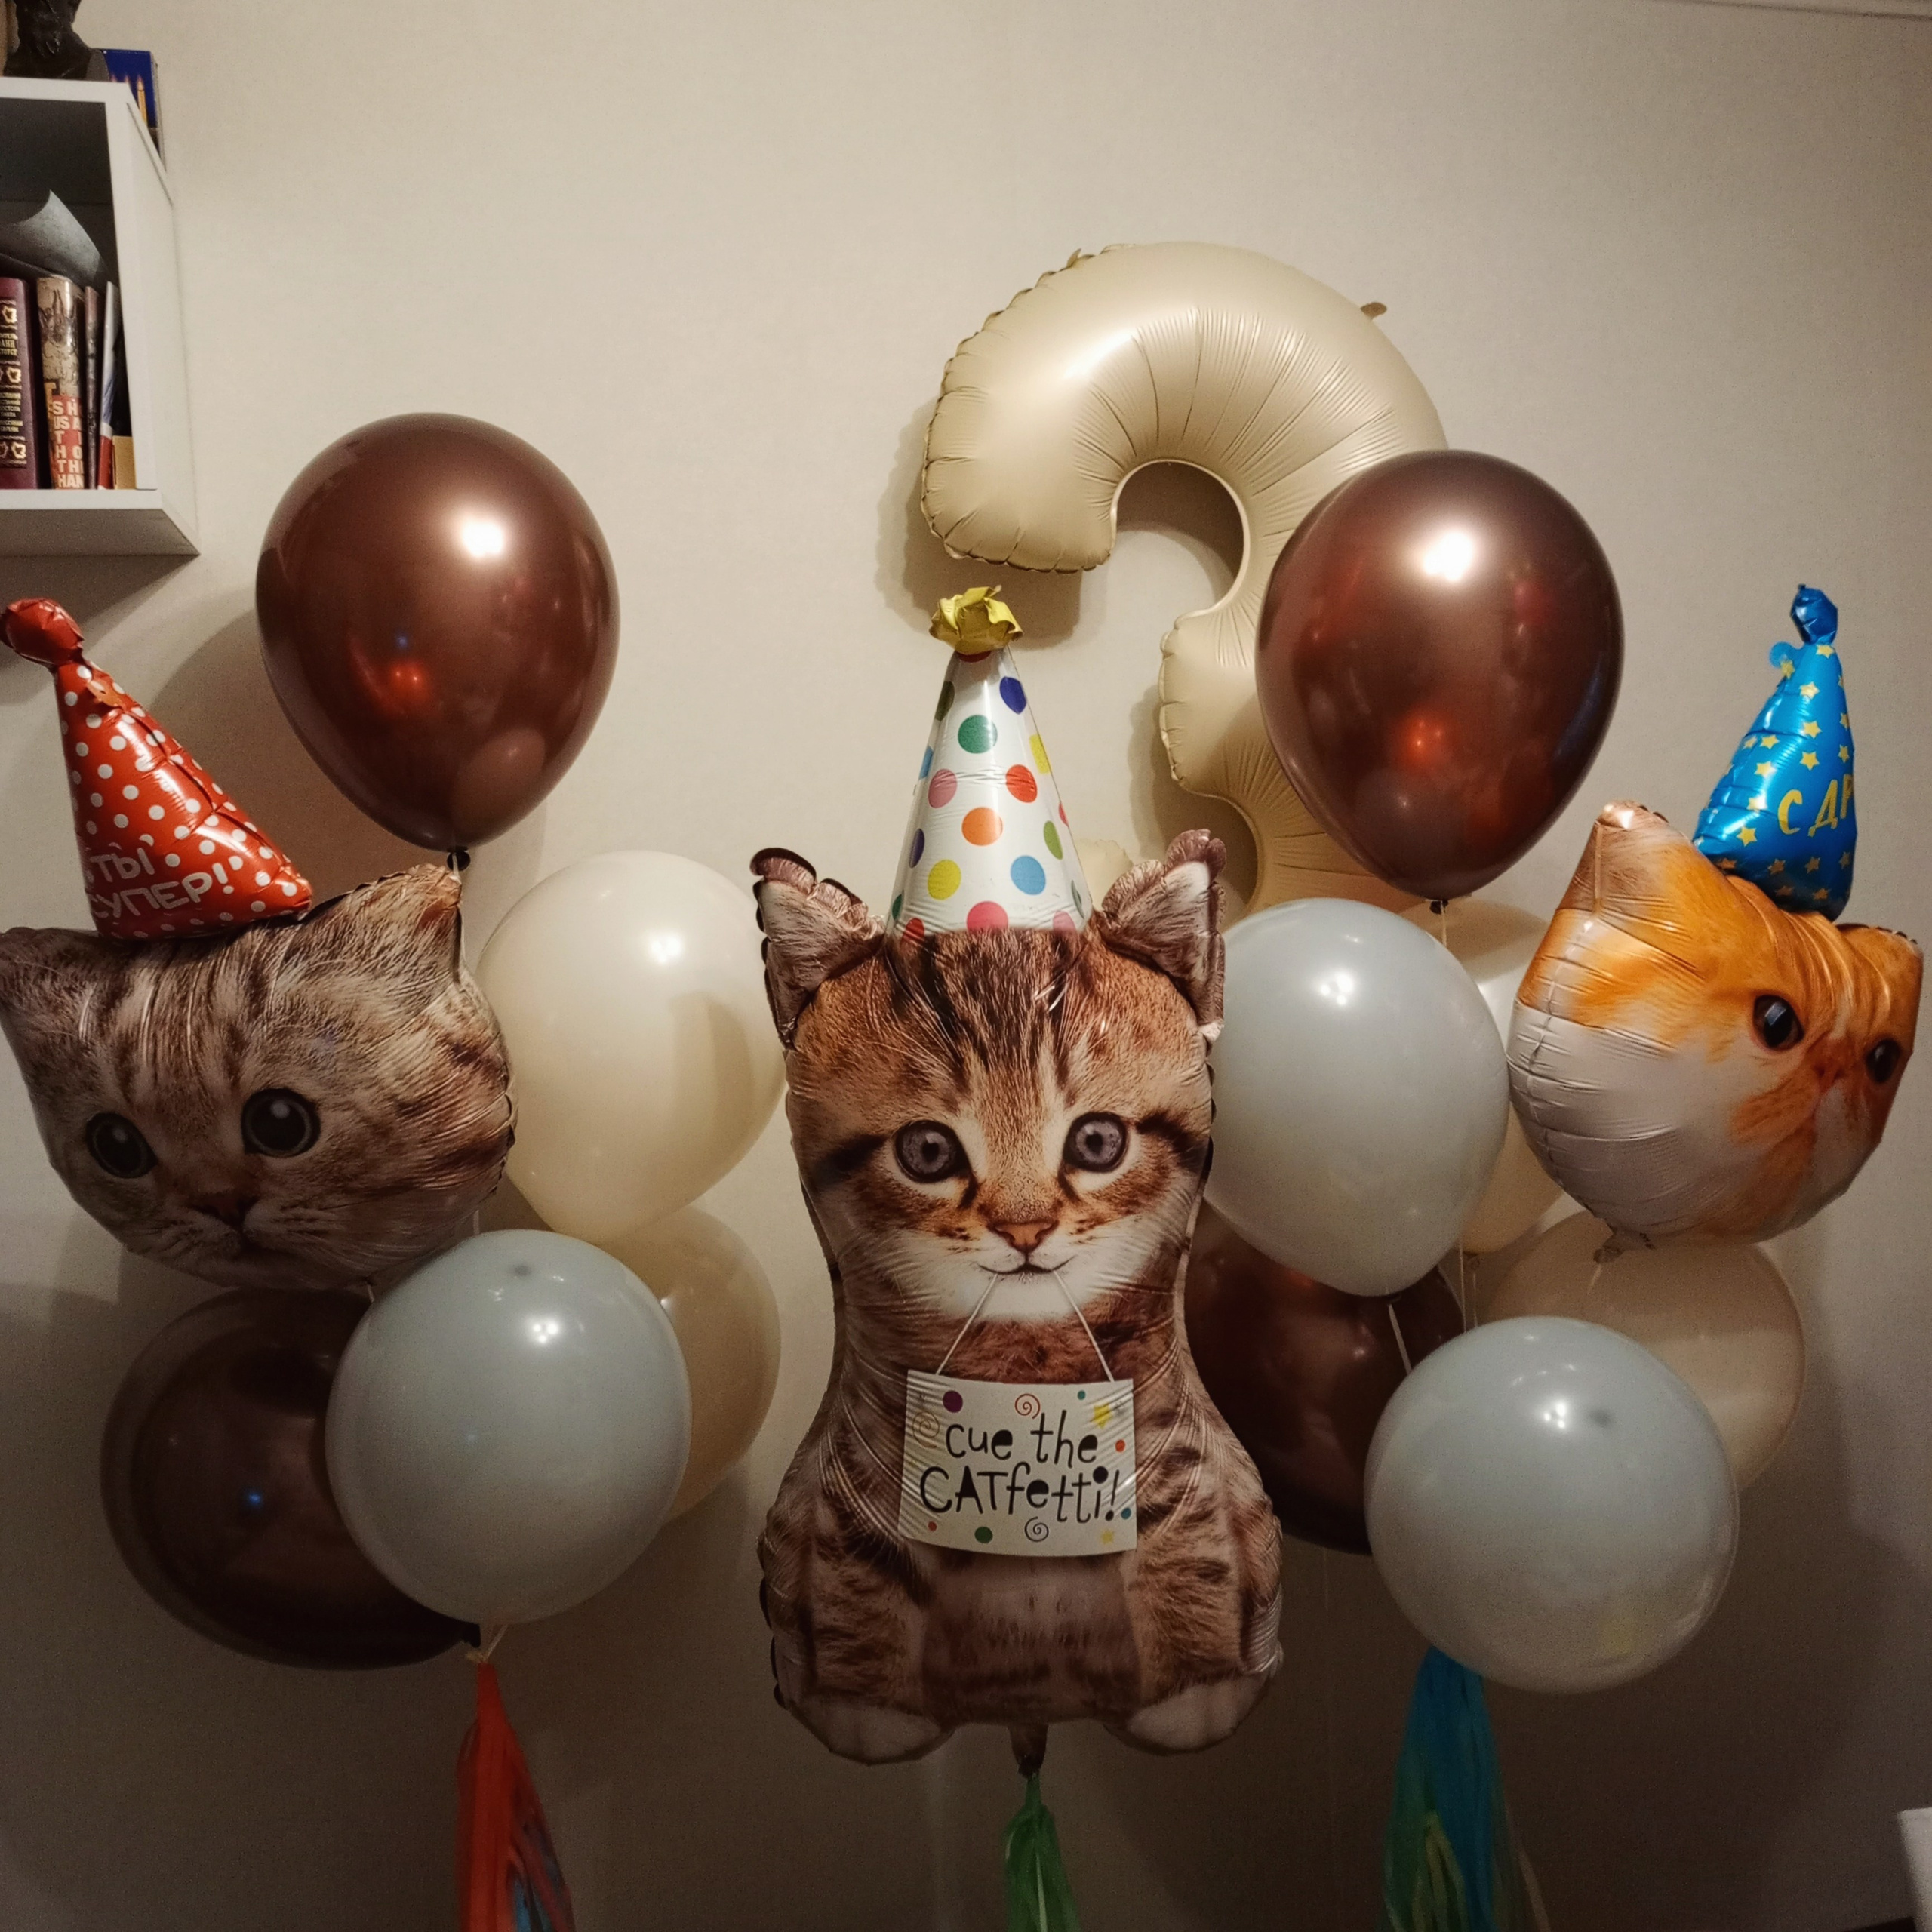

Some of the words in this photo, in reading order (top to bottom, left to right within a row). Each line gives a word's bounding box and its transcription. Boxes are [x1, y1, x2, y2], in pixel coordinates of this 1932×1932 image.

[1777, 789, 1803, 835] С
[89, 848, 155, 883] ТЫ
[946, 1424, 1014, 1460] cue
[1030, 1410, 1098, 1469] the
[920, 1461, 1120, 1524] CATfetti!
